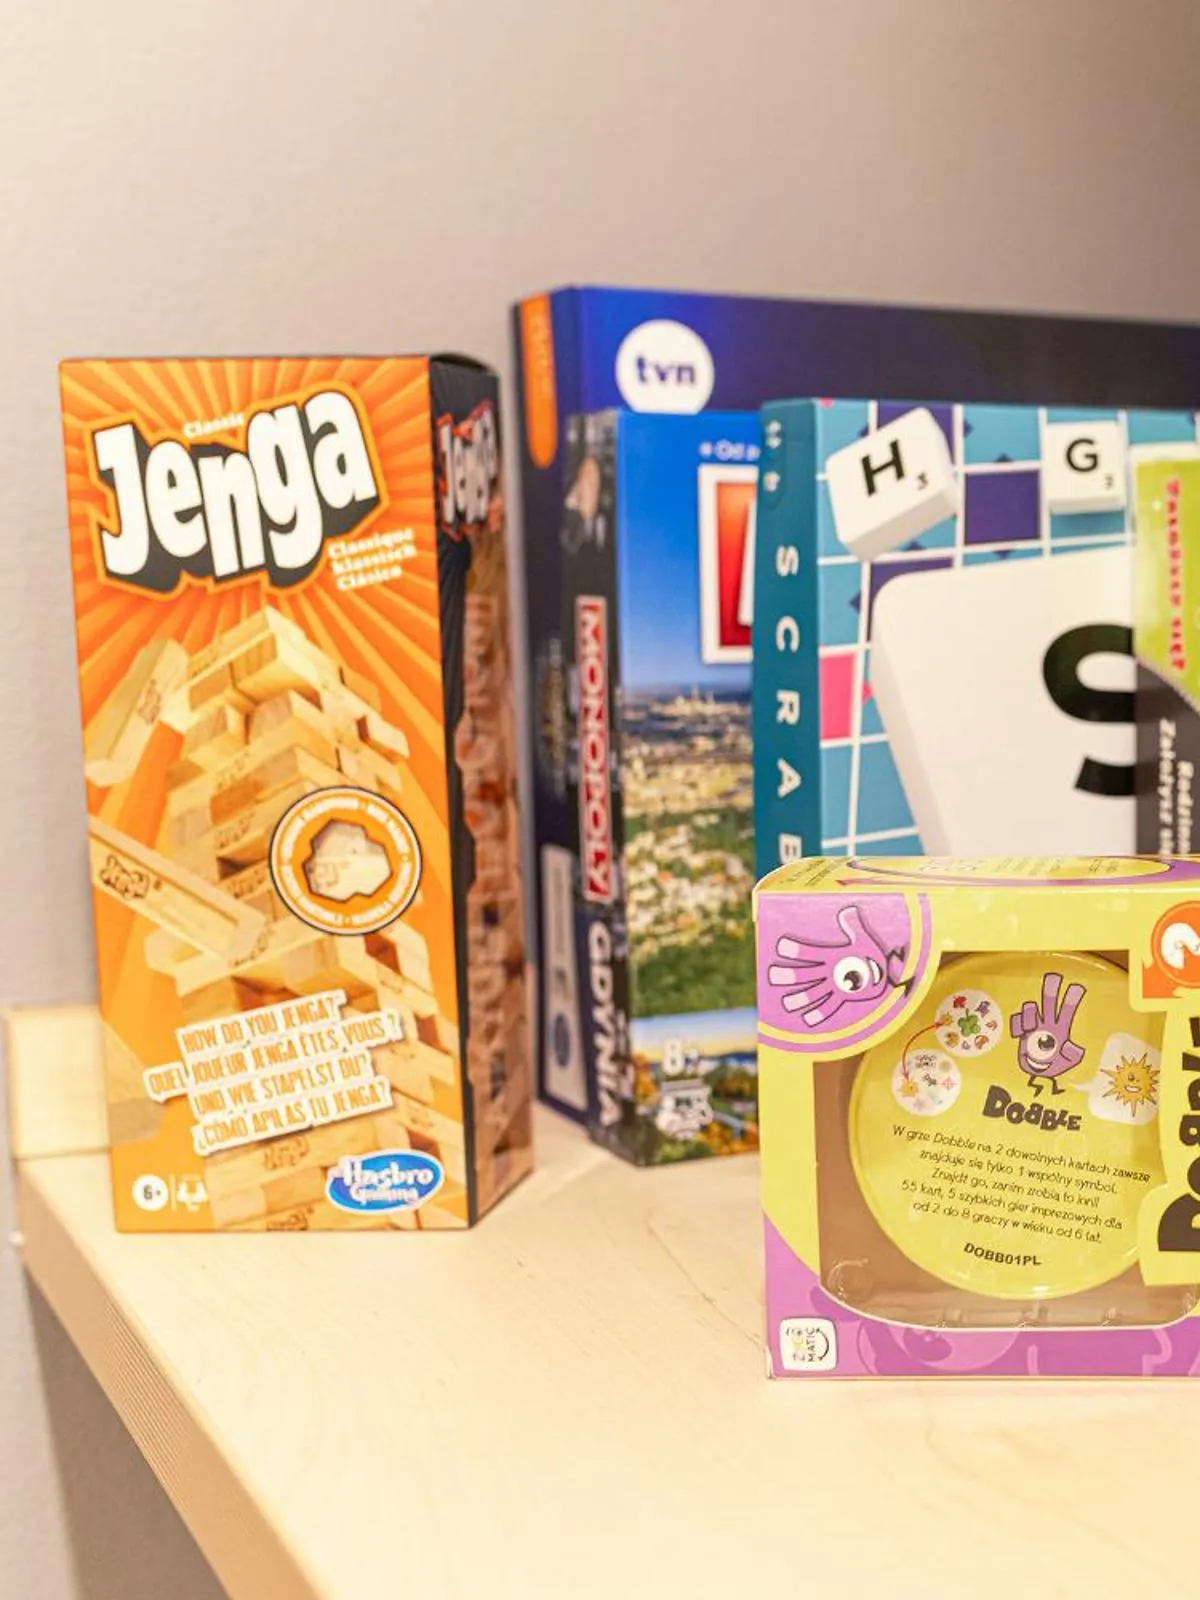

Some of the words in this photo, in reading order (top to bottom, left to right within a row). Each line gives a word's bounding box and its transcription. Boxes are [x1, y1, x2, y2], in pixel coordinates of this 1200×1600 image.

[635, 354, 697, 385] tvn
[184, 413, 244, 439] Classic
[861, 440, 905, 496] H
[1065, 438, 1099, 473] G
[93, 391, 377, 578] Jenga
[578, 602, 611, 895] MONOPOLY
[183, 1027, 218, 1054] HOW
[220, 1020, 244, 1045] DO
[246, 1012, 278, 1038] YOU
[281, 998, 336, 1031] JENGA?
[588, 920, 623, 1127] GDYNIA
[252, 1042, 299, 1070] JENGA
[983, 1085, 1082, 1131] DOBBLE
[333, 1157, 434, 1188] Hasbro
[893, 1124, 906, 1136] W
[906, 1128, 931, 1142] grze
[933, 1132, 977, 1149] Dobble
[977, 1142, 992, 1153] na
[995, 1143, 1004, 1155] 2
[1006, 1145, 1066, 1167] dowolnych
[1068, 1157, 1110, 1175] kartach
[1112, 1167, 1151, 1183] zawsze
[920, 1150, 966, 1167] znajduje
[968, 1157, 984, 1171] się
[986, 1160, 1014, 1175] tylko
[1018, 1165, 1025, 1177] 1
[1027, 1169, 1073, 1188] wspólny
[901, 1179, 917, 1192] 55
[948, 1187, 956, 1199] 5
[959, 1192, 1006, 1208] szybkich
[1007, 1201, 1029, 1213] gier
[1031, 1203, 1103, 1226] imprezowych
[1104, 1217, 1123, 1230] dla
[991, 1180, 1024, 1194] zanim
[1063, 1191, 1075, 1204] to
[912, 1201, 931, 1212] od
[932, 1202, 941, 1214] 2
[943, 1206, 960, 1217] do
[961, 1208, 971, 1219] 8
[972, 1212, 1011, 1229] graczy
[1055, 1227, 1073, 1238] od
[1074, 1228, 1083, 1240] 6
[963, 1242, 1043, 1267] DOBB01PL
